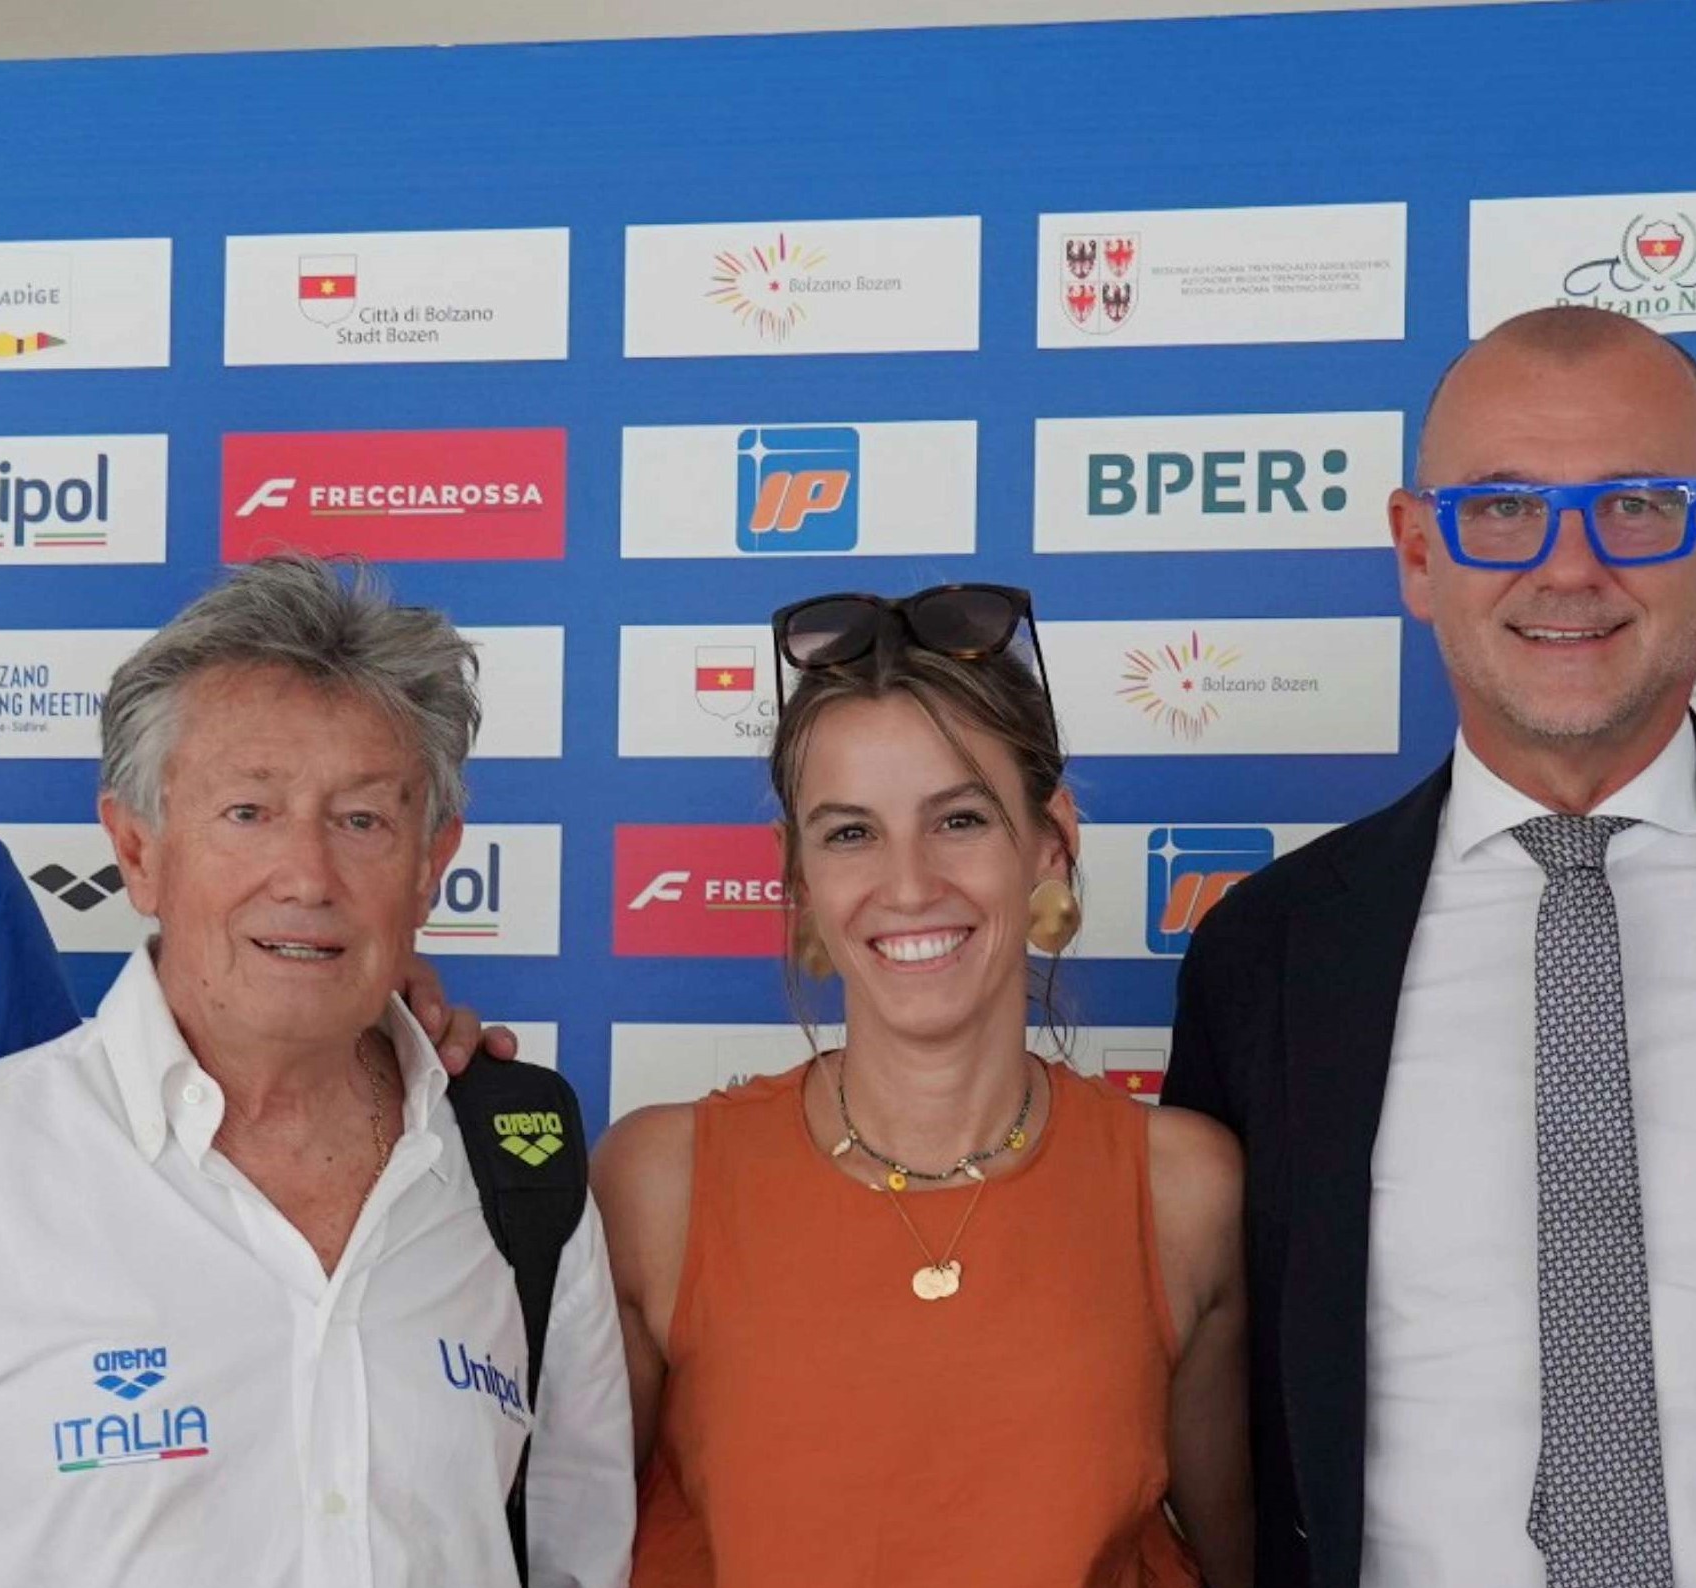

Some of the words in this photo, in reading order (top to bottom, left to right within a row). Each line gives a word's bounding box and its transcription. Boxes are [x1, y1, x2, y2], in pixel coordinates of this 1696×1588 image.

[788, 276, 851, 294] Bolzano
[856, 276, 901, 292] Bozen
[359, 306, 399, 323] Città
[404, 305, 420, 322] di
[425, 305, 494, 322] Bolzano
[336, 328, 382, 345] Stadt
[387, 327, 439, 344] Bozen
[309, 482, 543, 508] FRECCIAROSSA
[1201, 676, 1266, 693] Bolzano
[1271, 675, 1319, 693] Bozen
[30, 691, 106, 717] MEETIN
[493, 1111, 564, 1136] arena
[93, 1346, 167, 1372] arena
[54, 1404, 209, 1461] ITALIA
